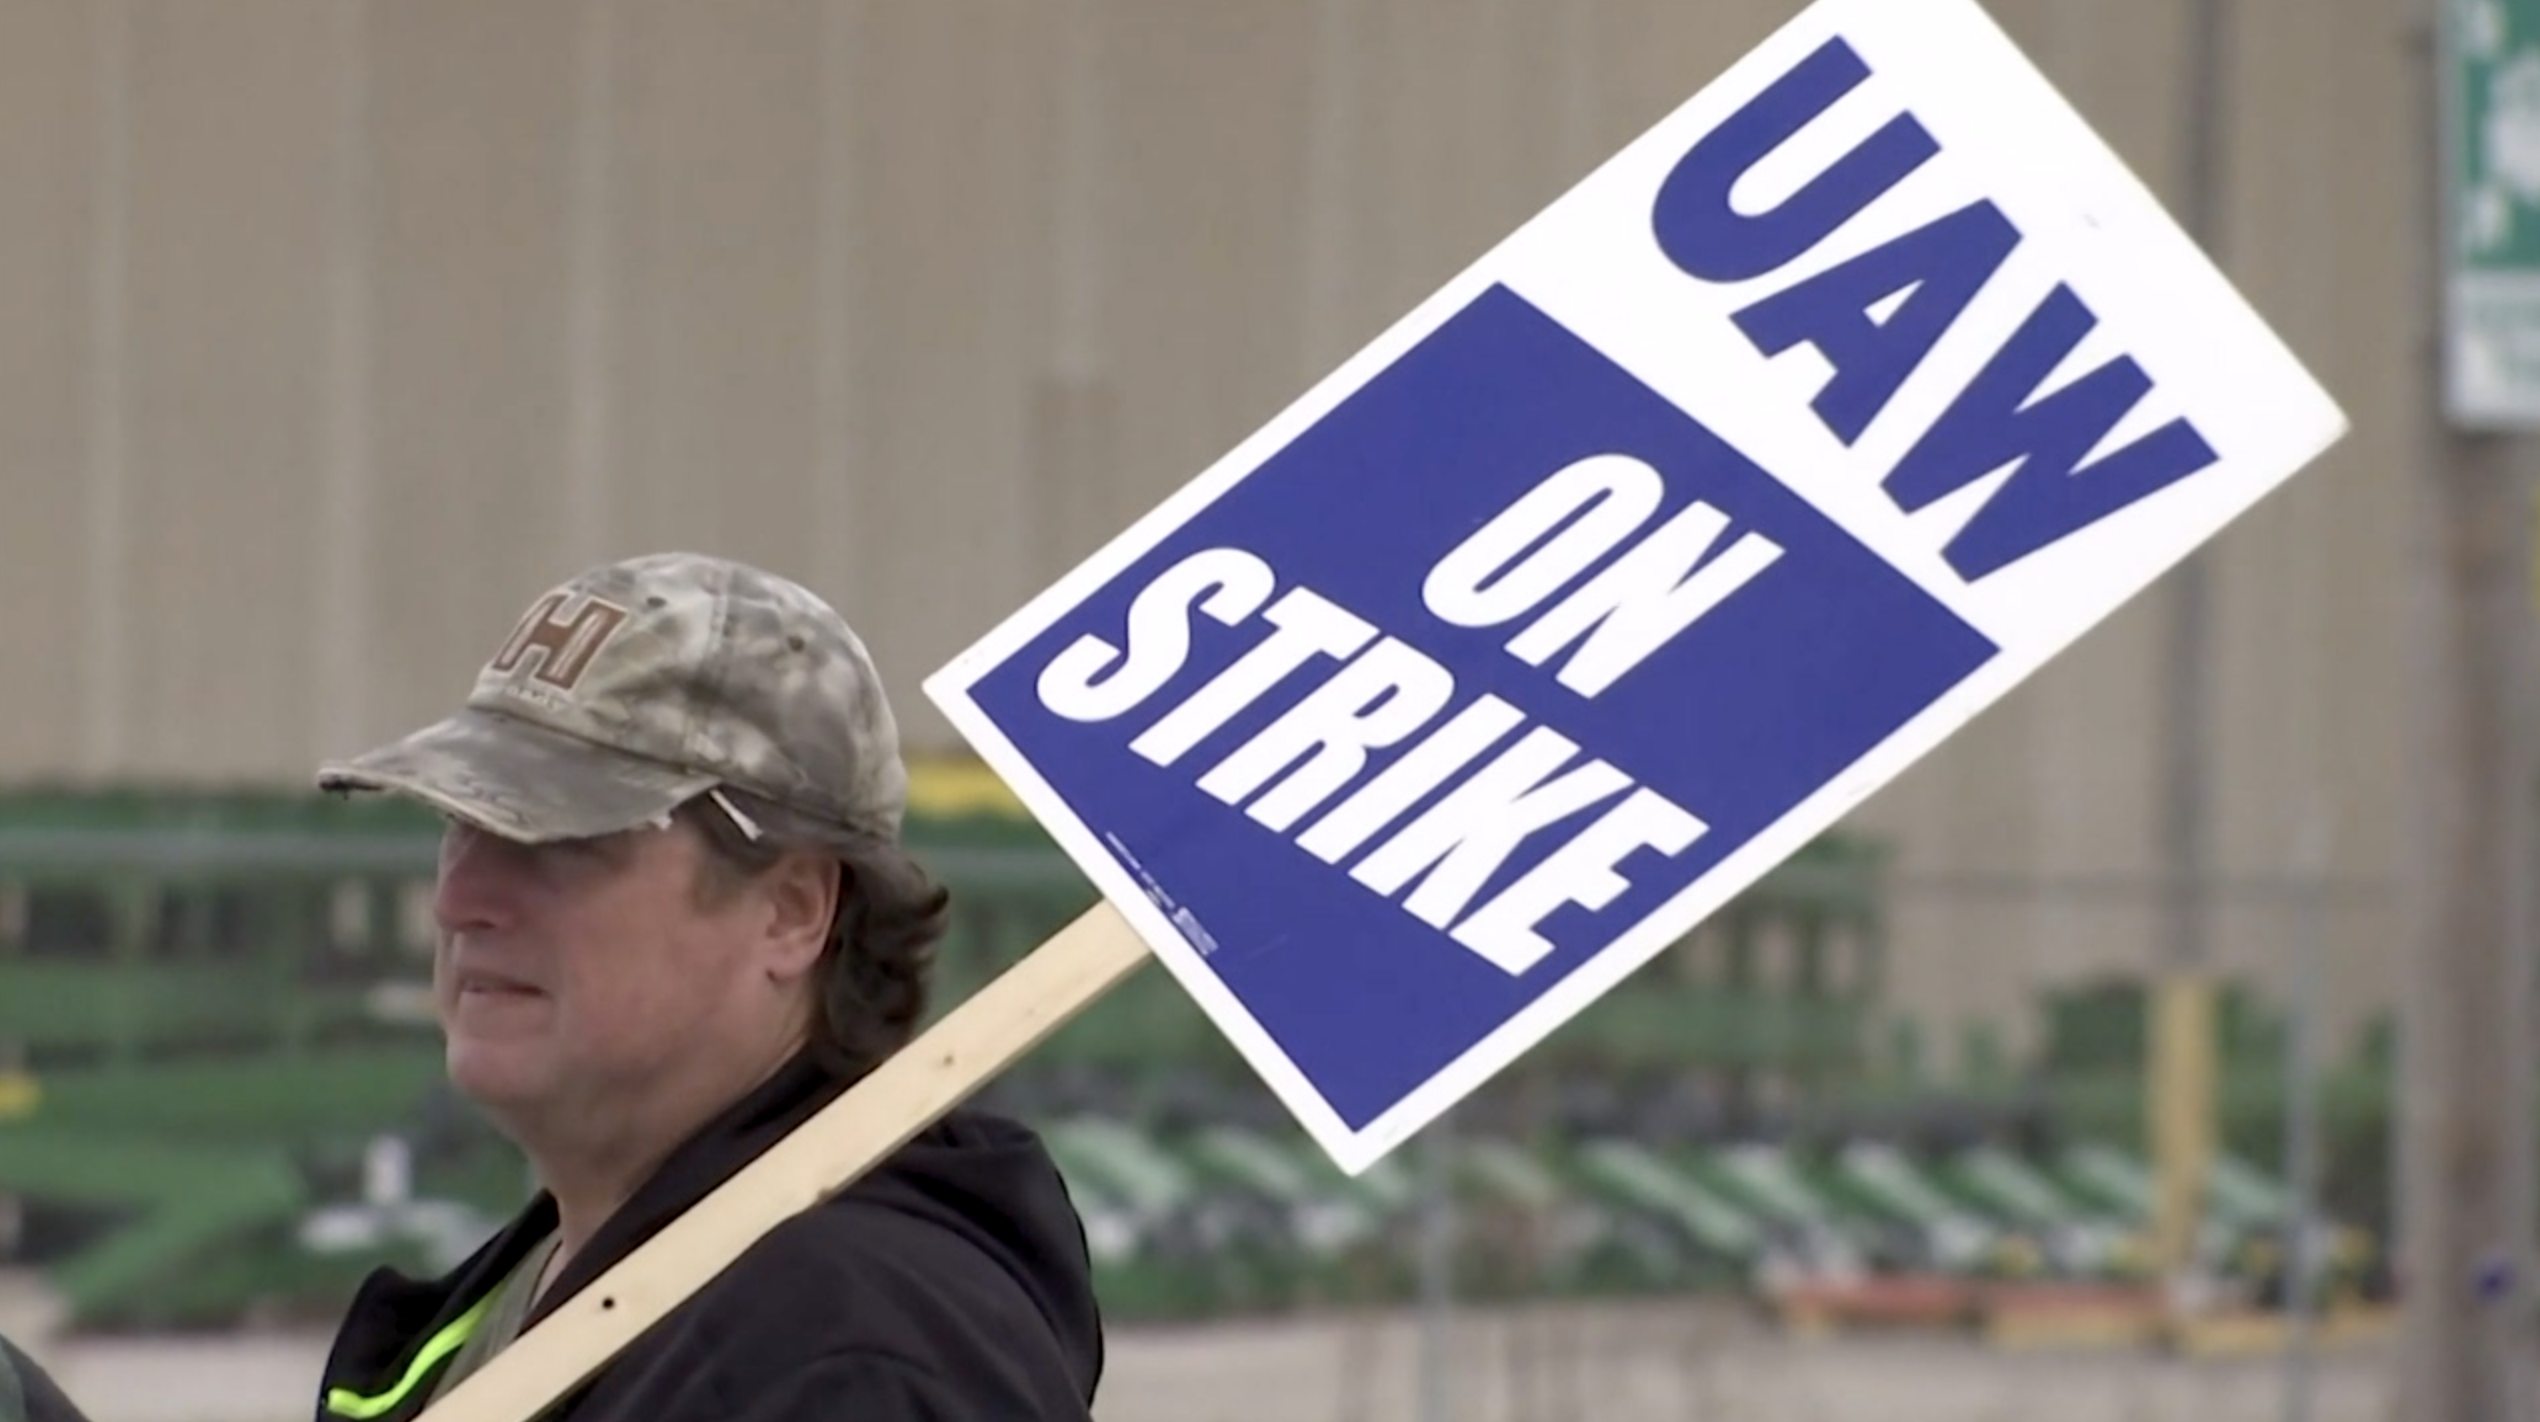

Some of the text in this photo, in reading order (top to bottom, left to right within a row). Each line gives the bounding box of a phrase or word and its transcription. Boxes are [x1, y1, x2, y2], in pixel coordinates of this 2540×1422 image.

[1652, 35, 2220, 583] UAW
[489, 590, 630, 693] H
[1421, 453, 1785, 699] ON
[1035, 547, 1710, 977] STRIKE
